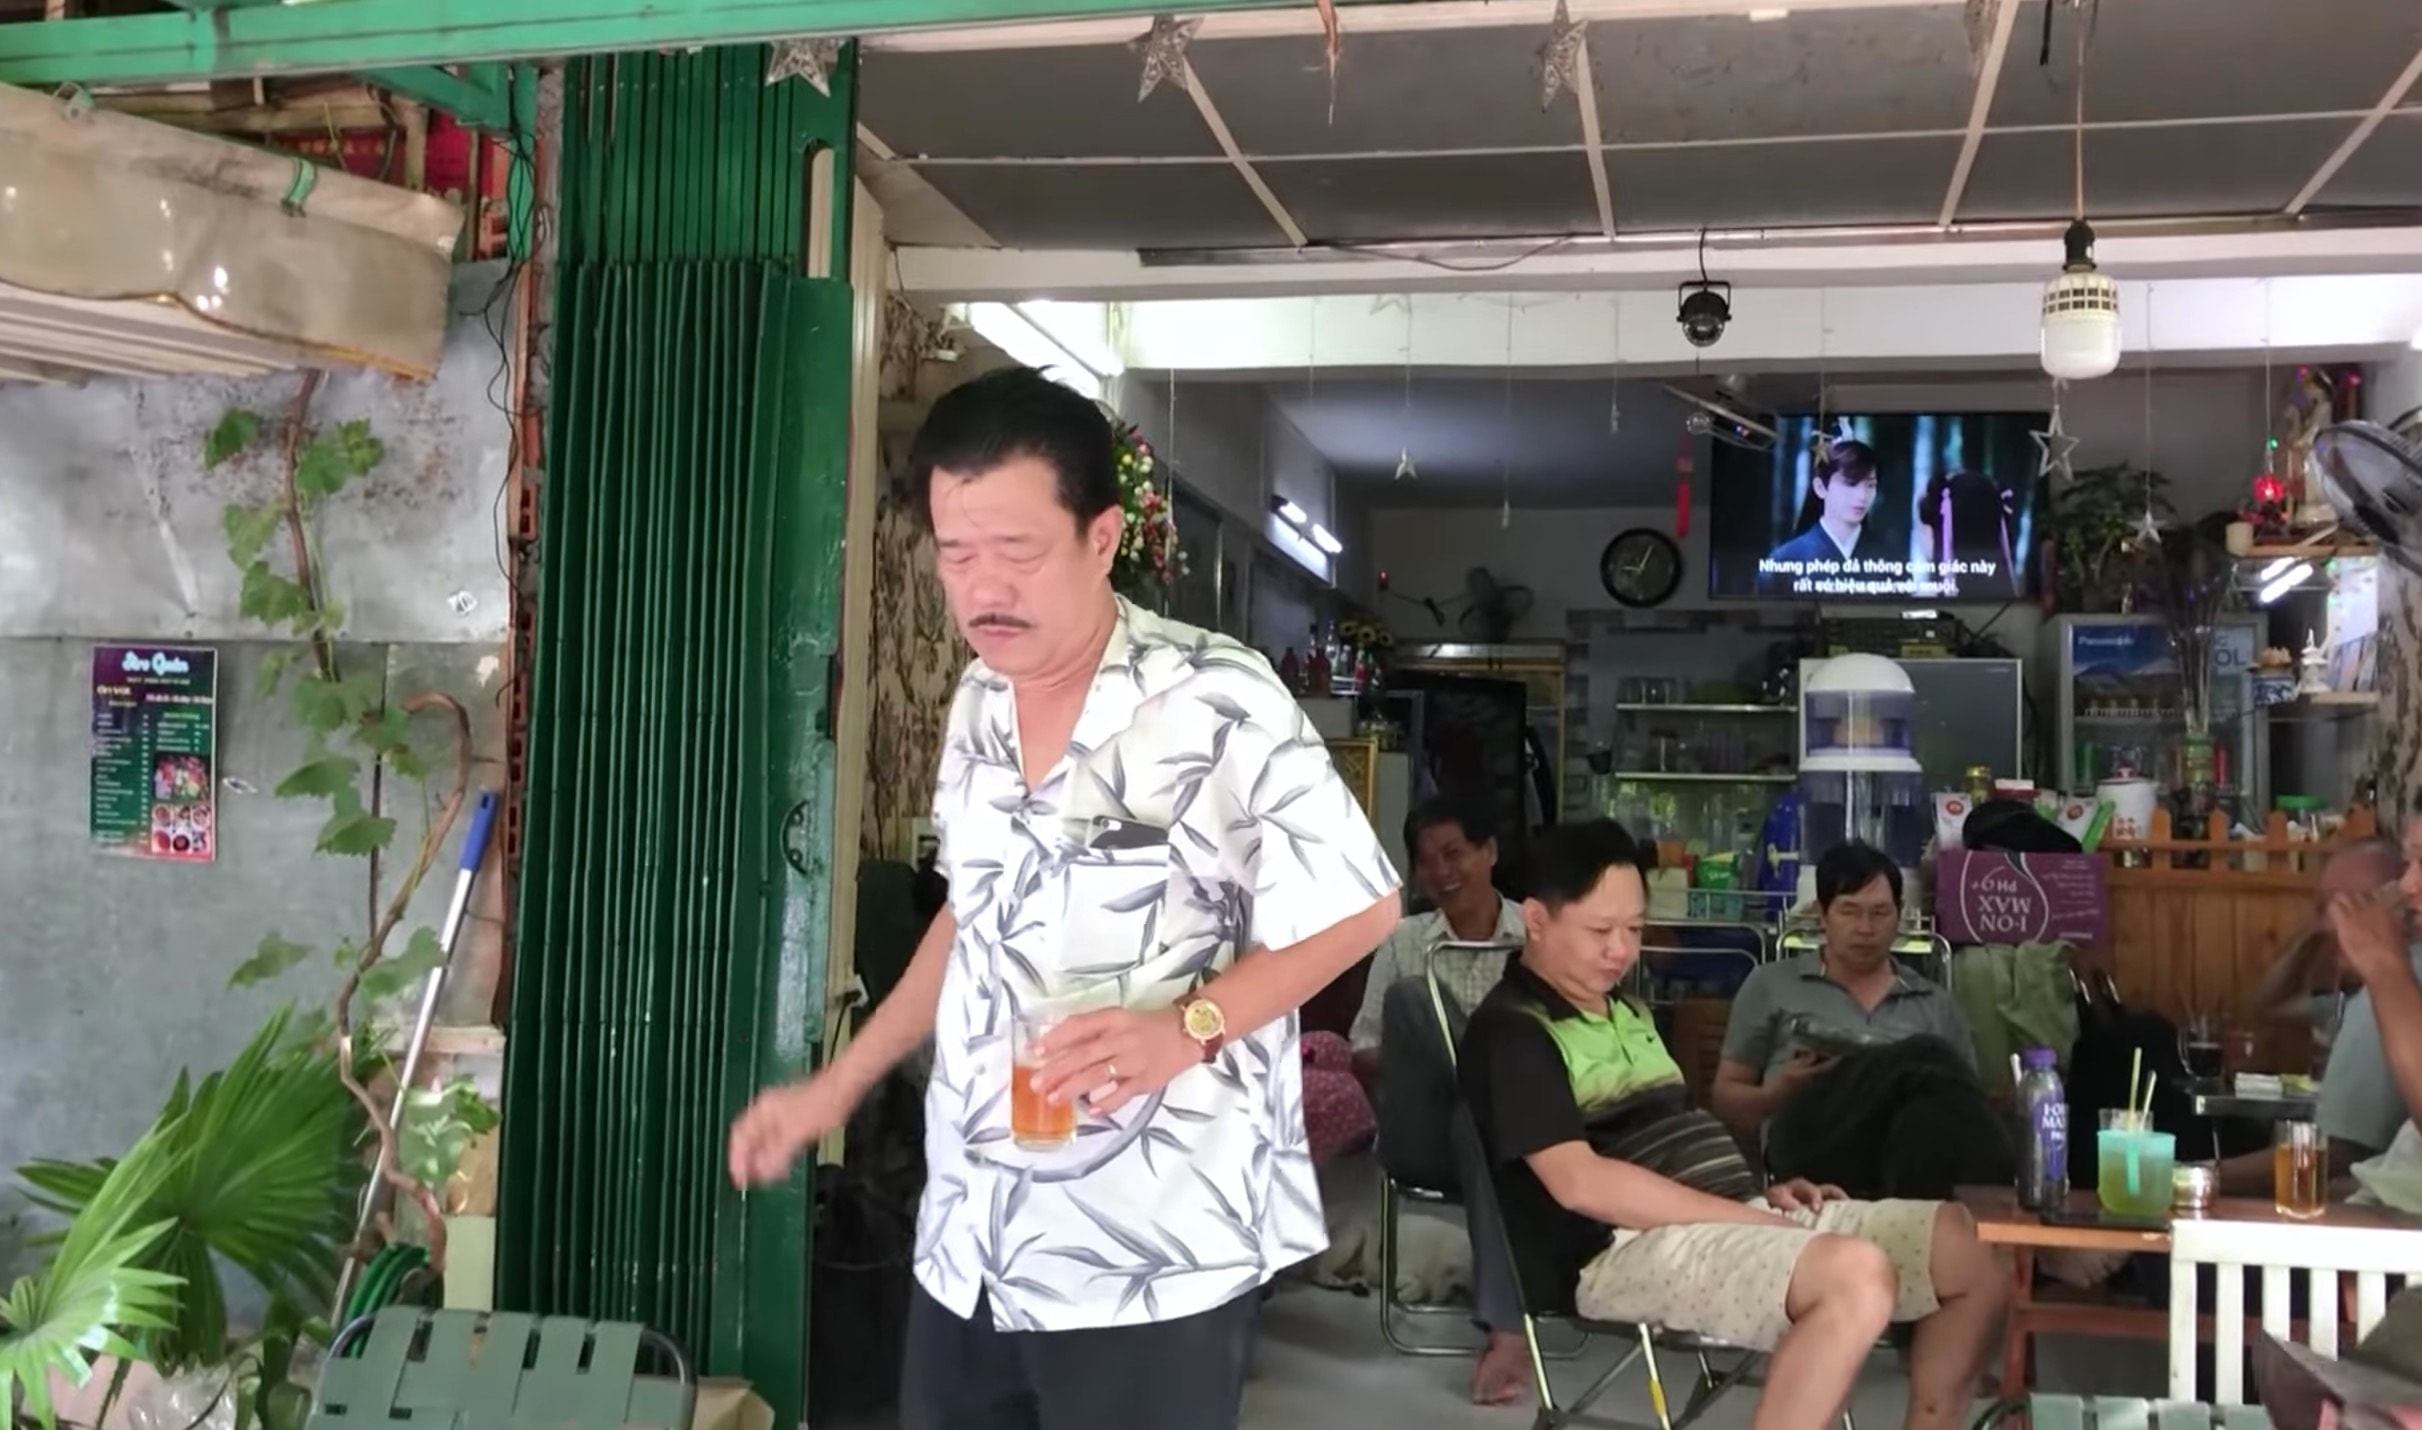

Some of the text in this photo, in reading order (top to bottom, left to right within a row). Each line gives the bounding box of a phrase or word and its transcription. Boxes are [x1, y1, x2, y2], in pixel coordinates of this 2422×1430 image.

[1759, 558, 1804, 575] Nhưng
[1806, 558, 1840, 575] phép
[1863, 558, 1903, 575] thông
[1938, 558, 1967, 575] giác
[1971, 559, 1996, 576] này
[1977, 895, 2032, 914] MAX
